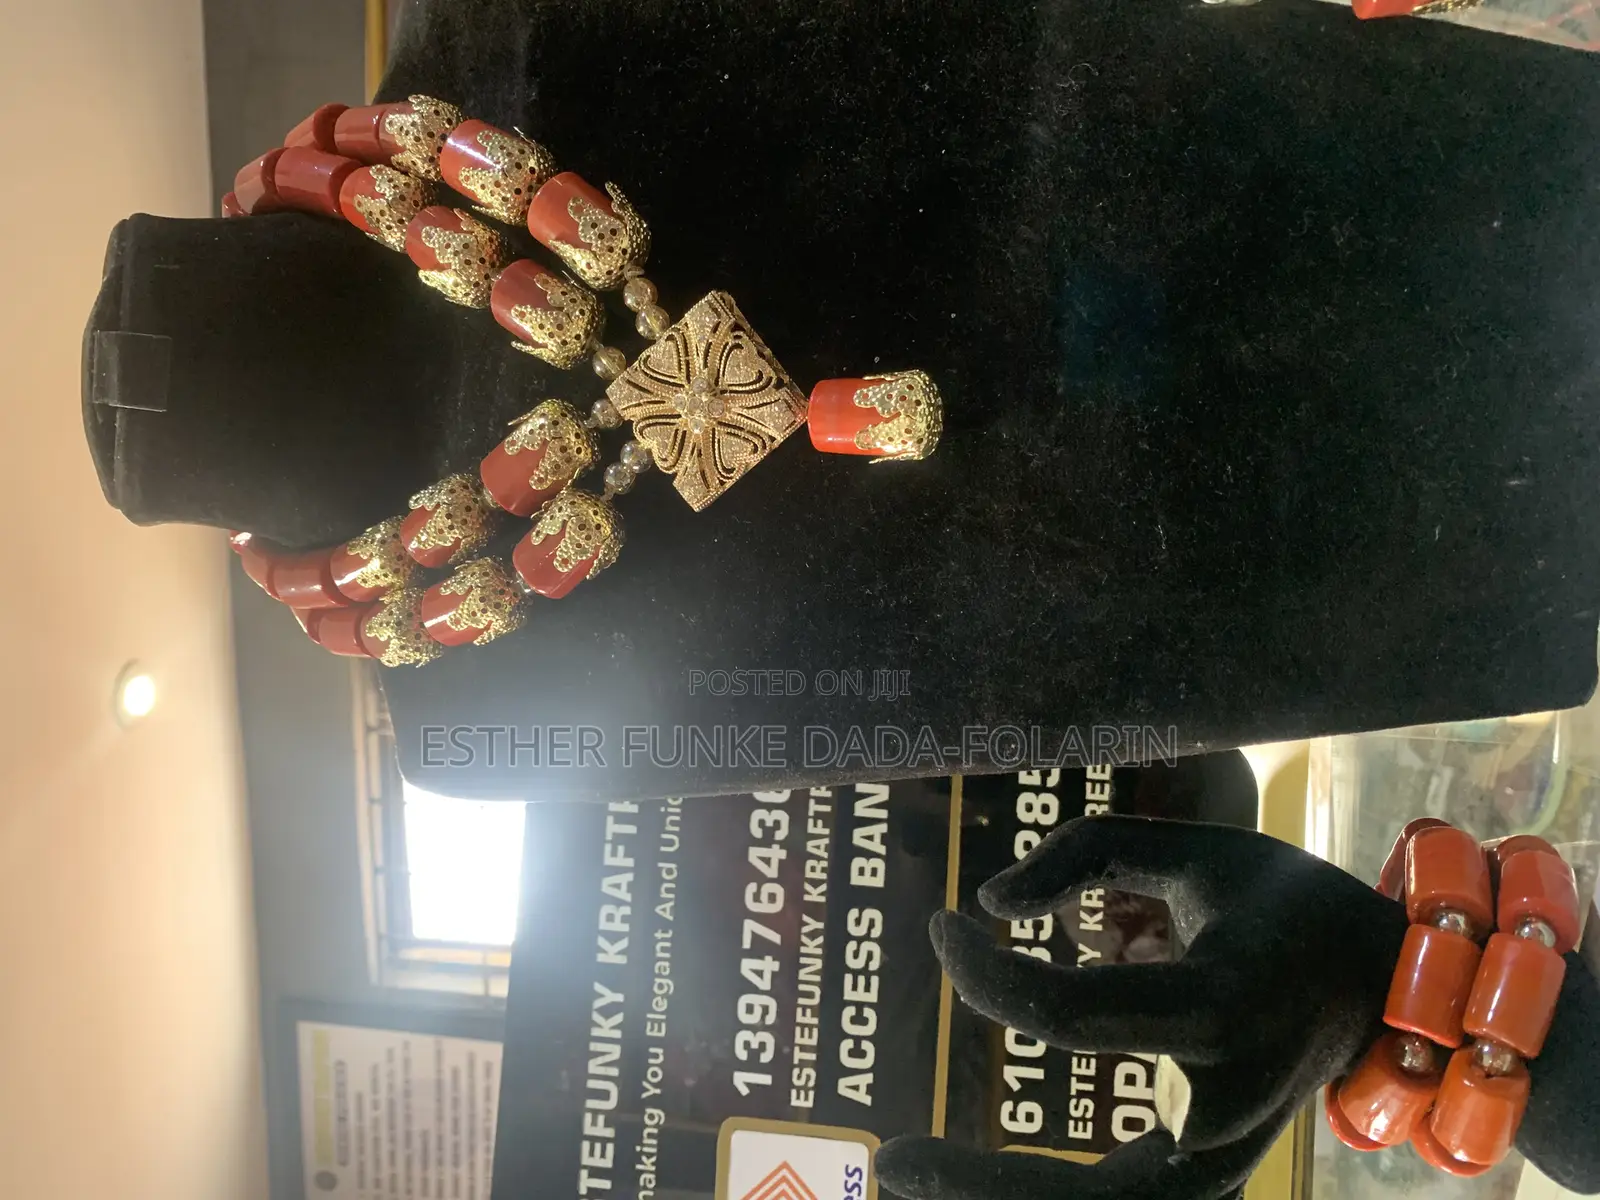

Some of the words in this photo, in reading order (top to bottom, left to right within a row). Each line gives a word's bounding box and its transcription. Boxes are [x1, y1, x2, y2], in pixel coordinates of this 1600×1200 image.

[654, 862, 679, 922] And
[645, 928, 675, 1038] Elegant
[790, 913, 825, 1109] ESTEFUNKY
[837, 907, 884, 1107] ACCESS
[578, 981, 625, 1200] TEFUNKY
[641, 1047, 665, 1099] You
[843, 1164, 863, 1200] ss
